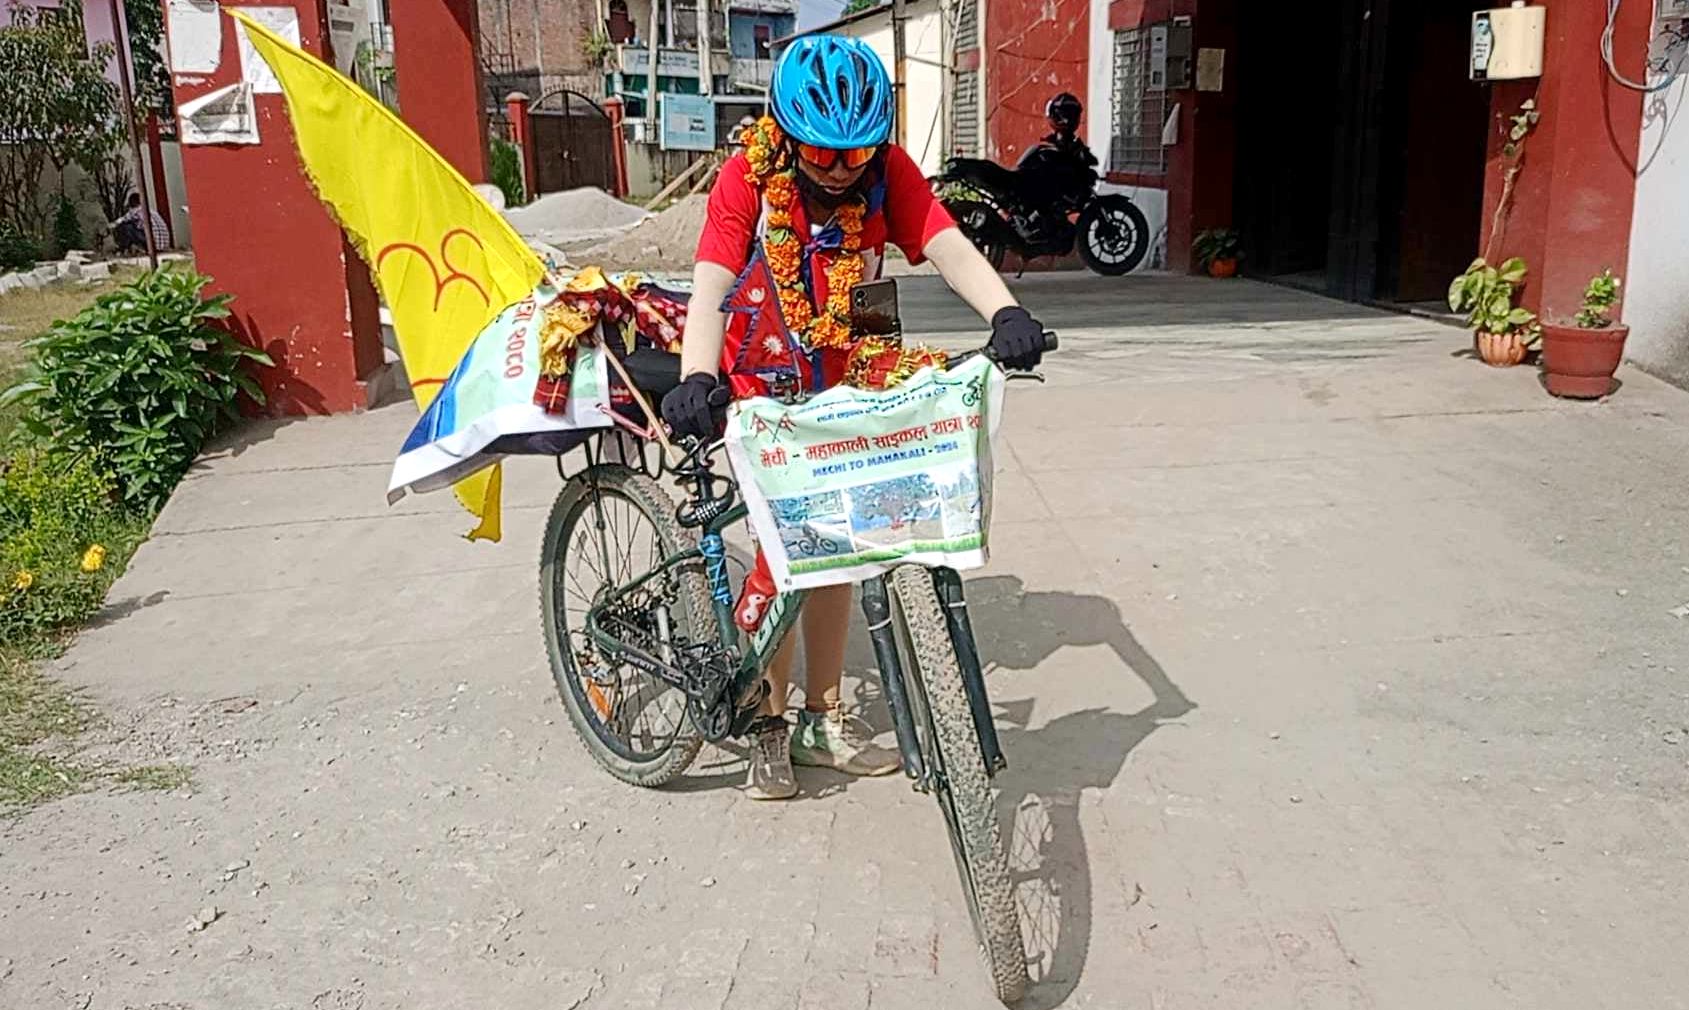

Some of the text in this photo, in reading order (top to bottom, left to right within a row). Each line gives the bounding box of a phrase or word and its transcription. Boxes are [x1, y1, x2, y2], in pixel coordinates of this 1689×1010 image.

[804, 435, 870, 460] महाकाली
[872, 426, 928, 448] साइकल
[930, 417, 963, 435] यात्रा
[812, 463, 847, 477] MECHI
[849, 459, 864, 470] TO
[867, 447, 926, 467] MAHAKALI
